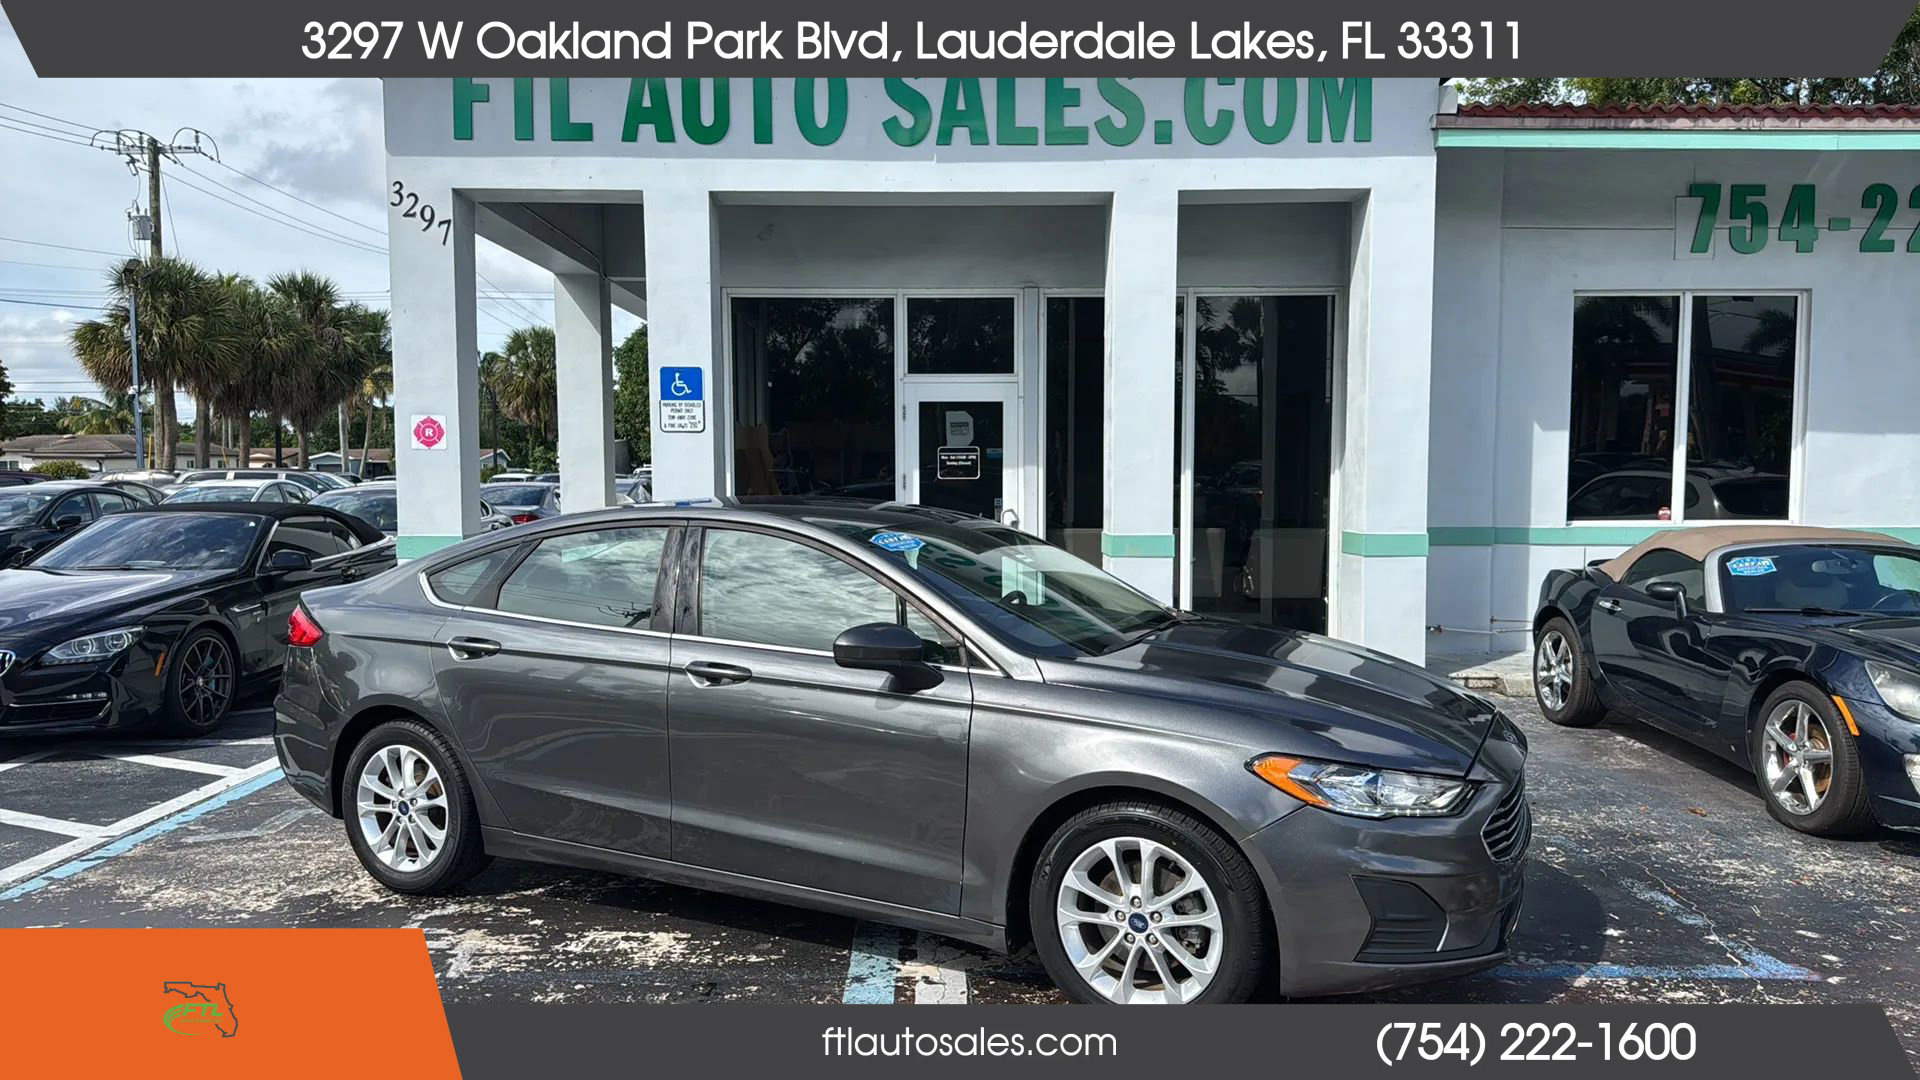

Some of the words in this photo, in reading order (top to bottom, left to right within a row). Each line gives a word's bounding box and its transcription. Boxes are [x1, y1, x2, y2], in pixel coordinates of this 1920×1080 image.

[453, 78, 593, 142] FTL
[621, 78, 849, 147] AUTO
[882, 78, 1374, 147] SALES.COM
[390, 180, 452, 246] 3297
[1689, 184, 1920, 253] 754-2
[425, 428, 433, 436] R
